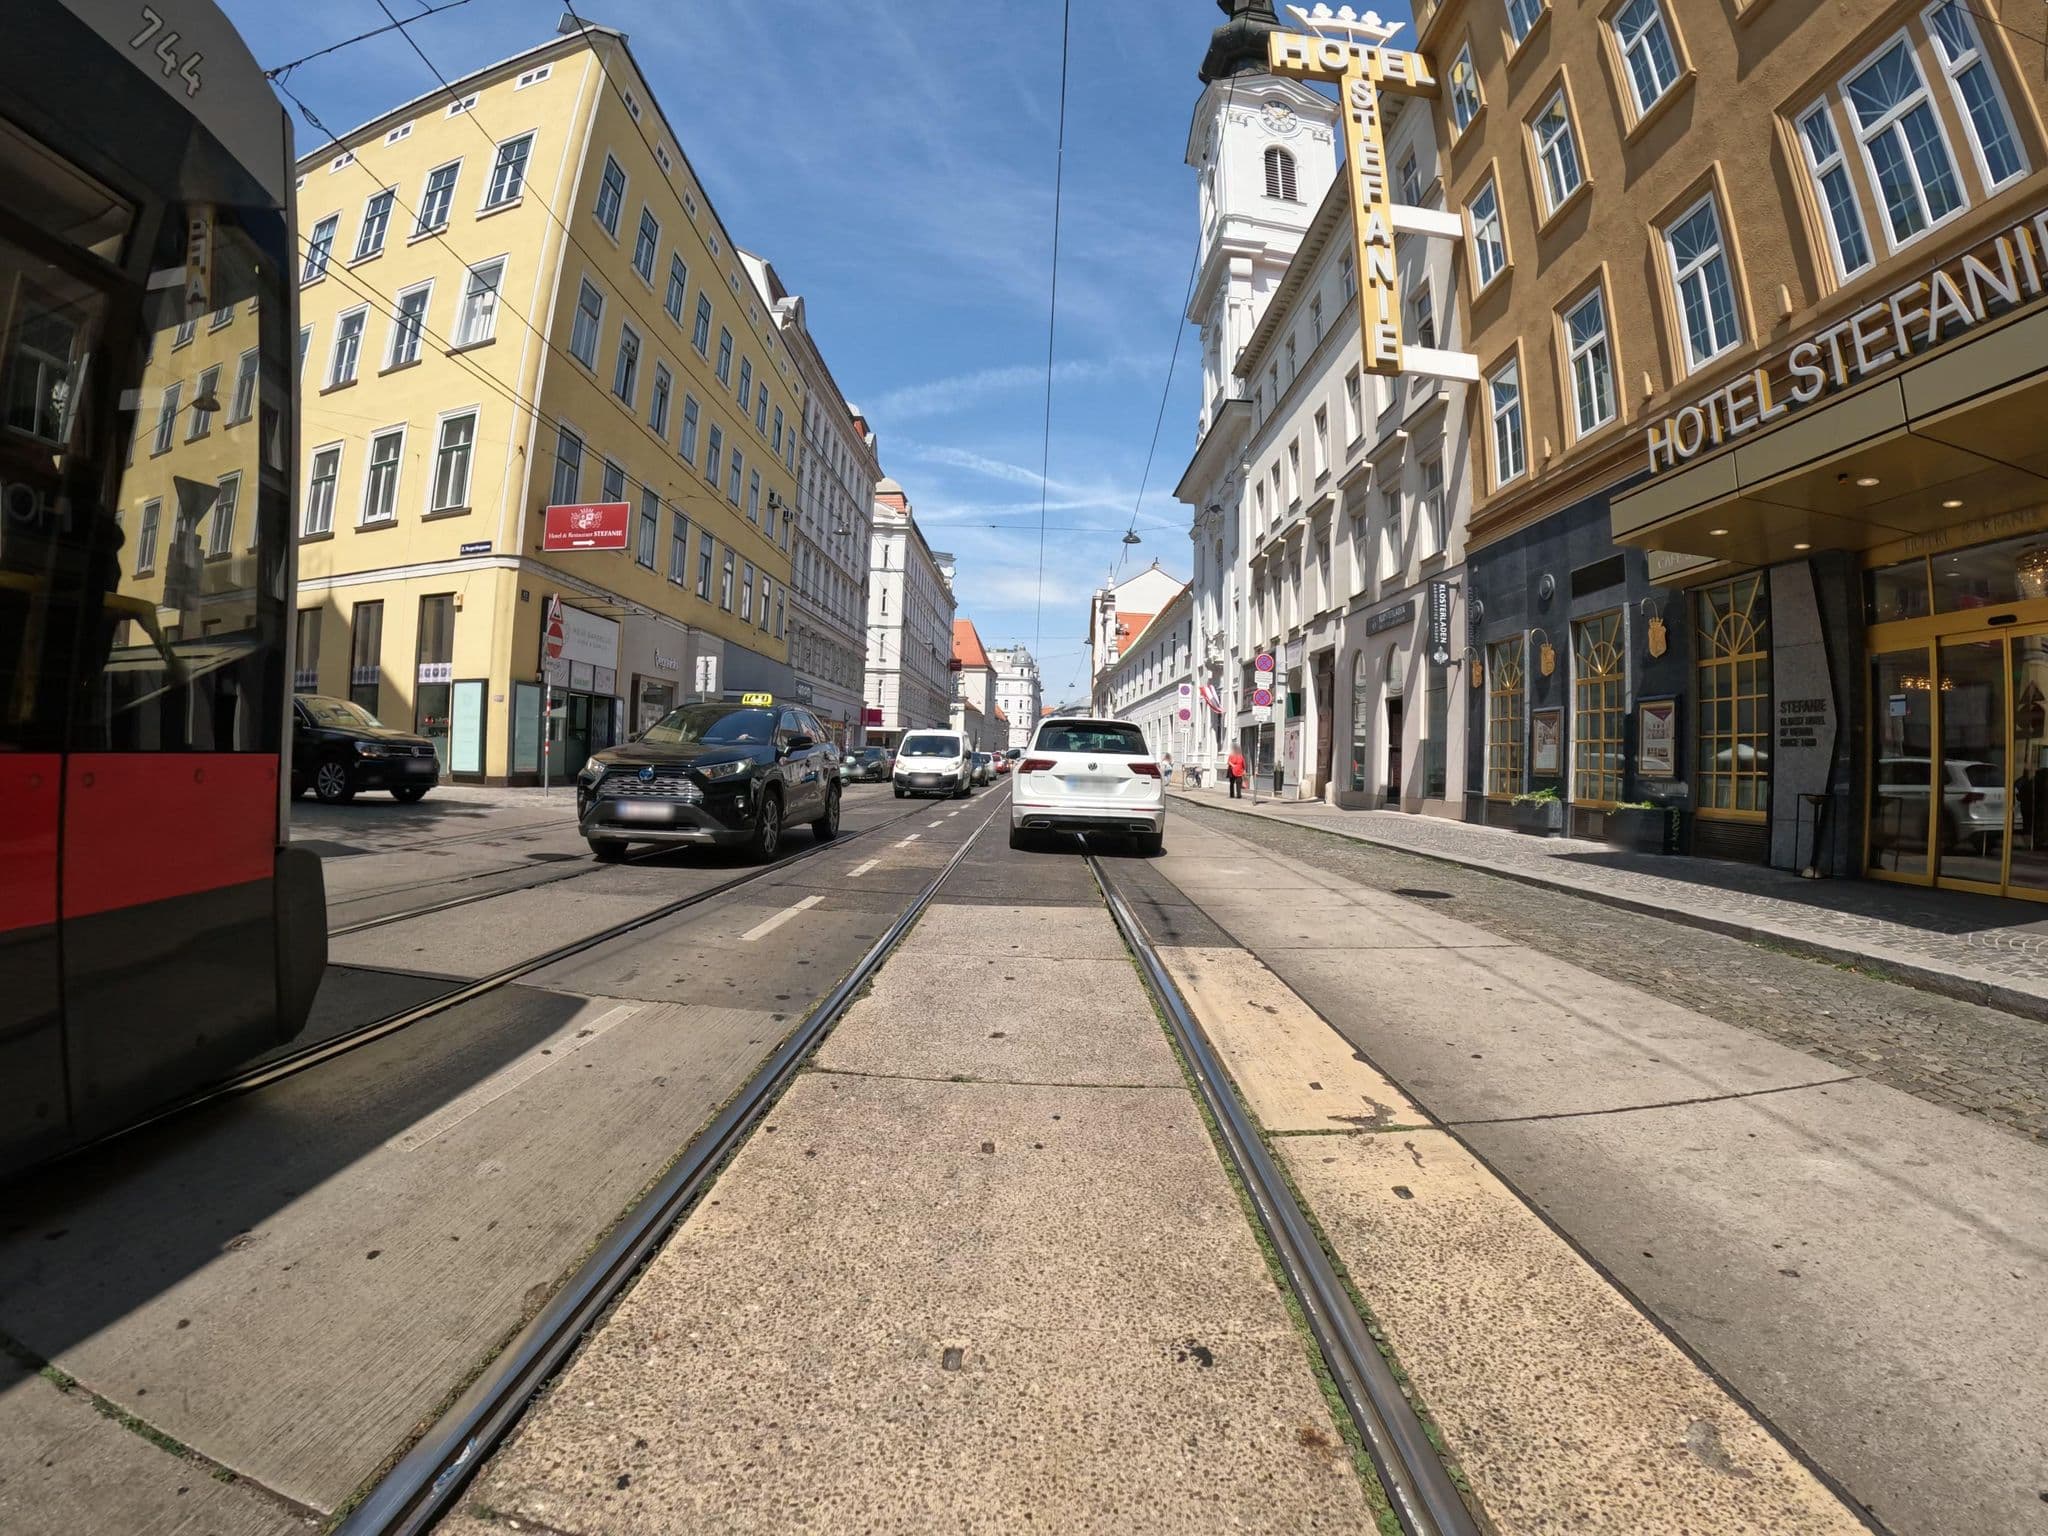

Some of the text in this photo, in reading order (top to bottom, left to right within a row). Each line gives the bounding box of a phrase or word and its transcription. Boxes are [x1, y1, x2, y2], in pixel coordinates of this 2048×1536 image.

[129, 5, 203, 98] 744
[1278, 32, 1436, 87] HOTEL
[1350, 79, 1399, 361] STEFANIE
[1648, 368, 1787, 472] HOTEL
[593, 529, 623, 537] STEFANIE
[1439, 583, 1448, 644] KLOSTERLADEN
